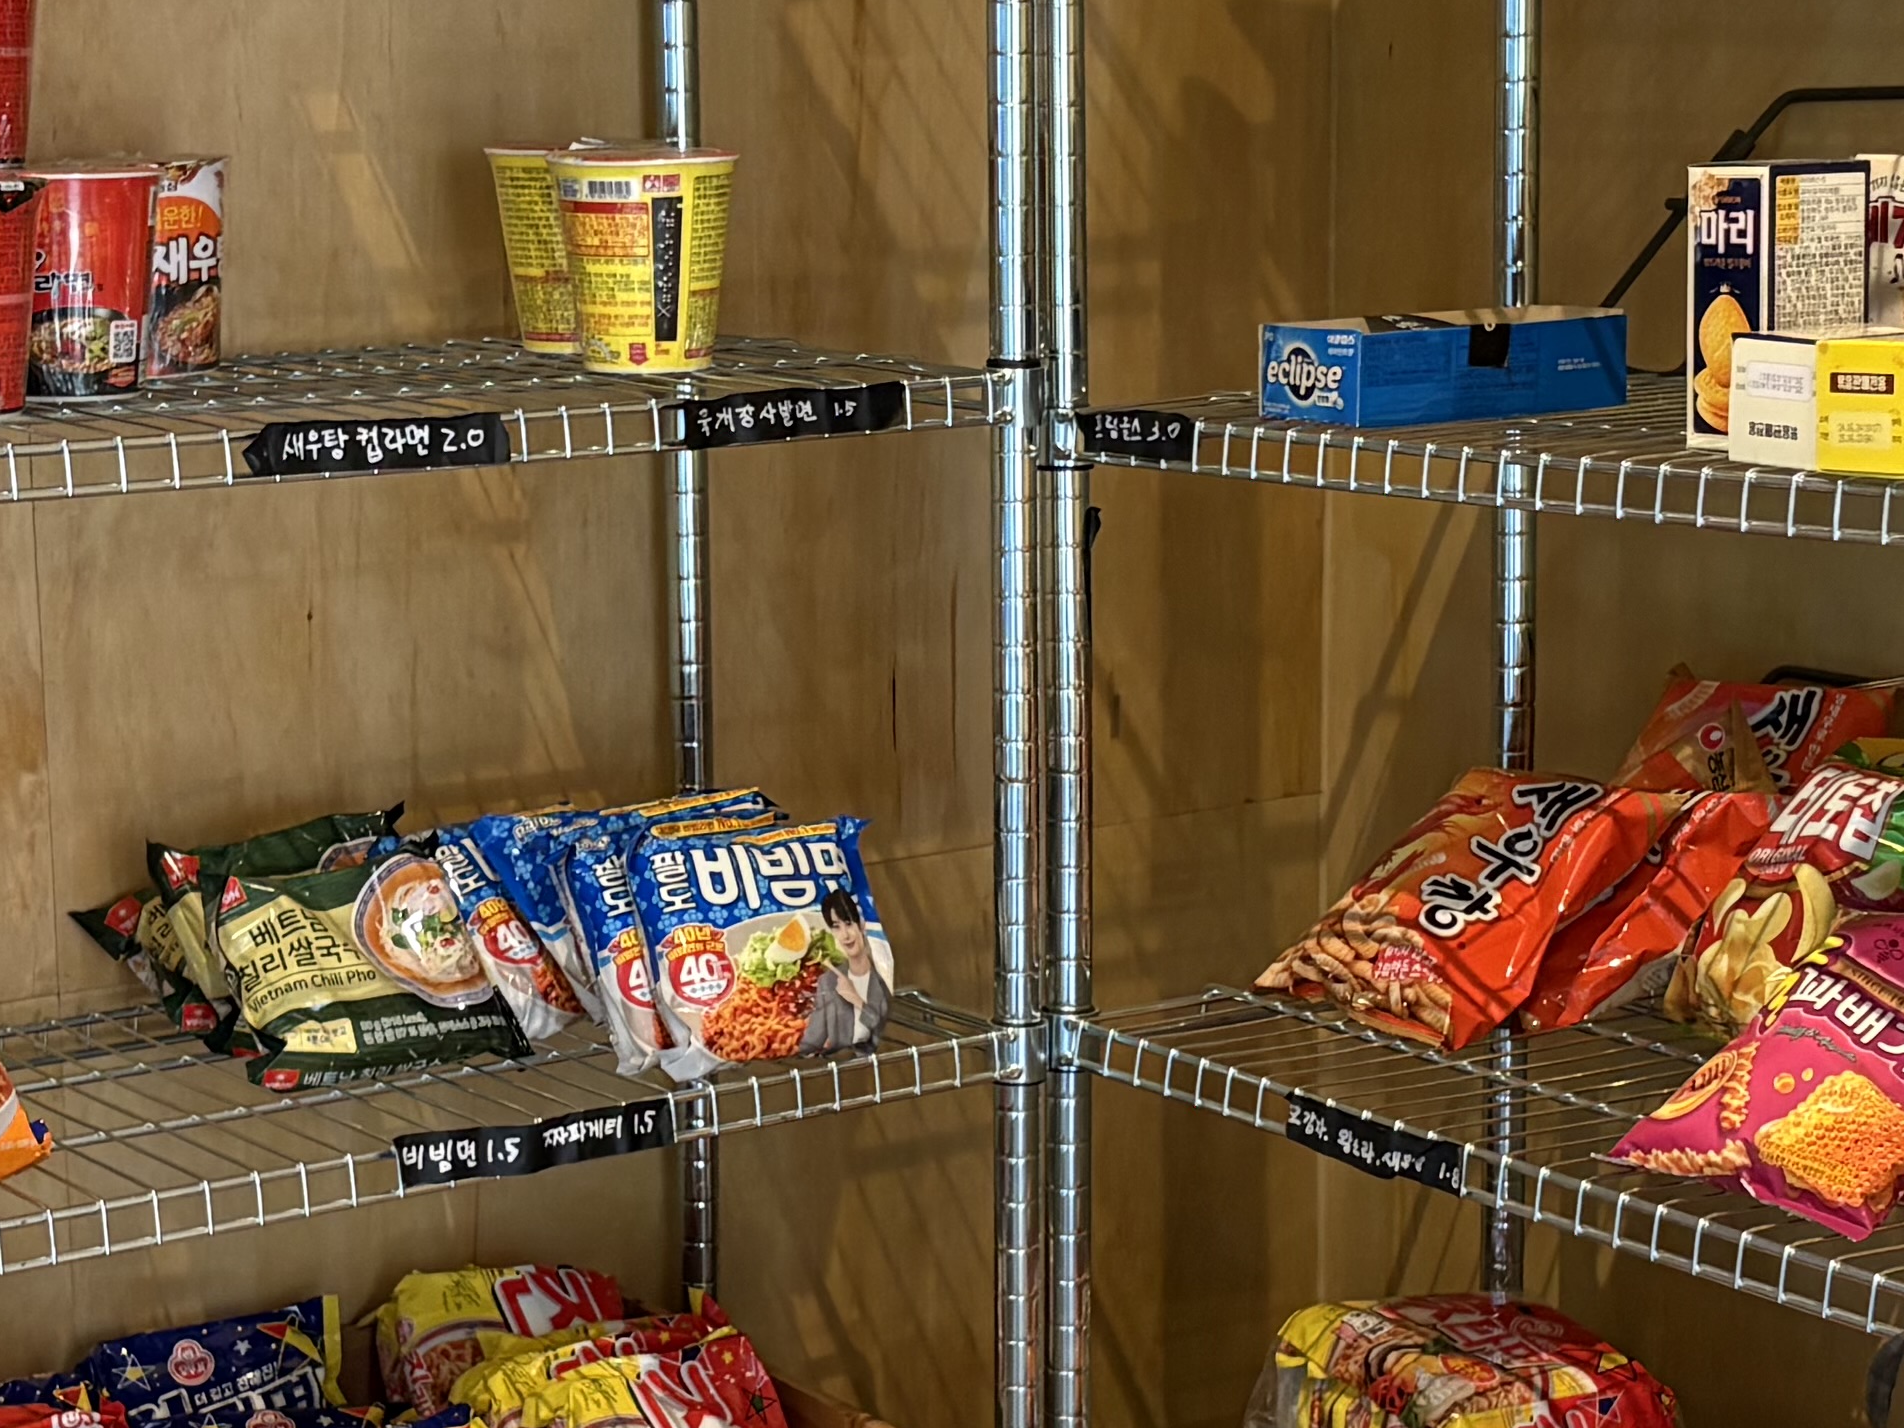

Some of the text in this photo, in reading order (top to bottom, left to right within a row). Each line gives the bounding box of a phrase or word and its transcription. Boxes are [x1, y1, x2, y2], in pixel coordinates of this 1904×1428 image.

[1700, 209, 1755, 254] 마리
[1267, 357, 1343, 397] eclipse
[834, 401, 857, 417] 1.5
[283, 425, 484, 464] 새우탕 컵라면 2.0
[1146, 420, 1181, 441] 3.0
[1419, 782, 1605, 938] 새우깡
[1748, 842, 1806, 864] ORIGINAL
[650, 851, 696, 914] 팔도
[248, 907, 329, 949] 베트남
[671, 925, 712, 945] 40년
[679, 953, 718, 984] 40
[247, 967, 377, 1013] Vietnam Chili Pho
[402, 1139, 476, 1174] 비빔면
[487, 1138, 521, 1163] 1.5
[634, 1111, 656, 1134] 1.5
[1439, 1161, 1459, 1189] 1.8
